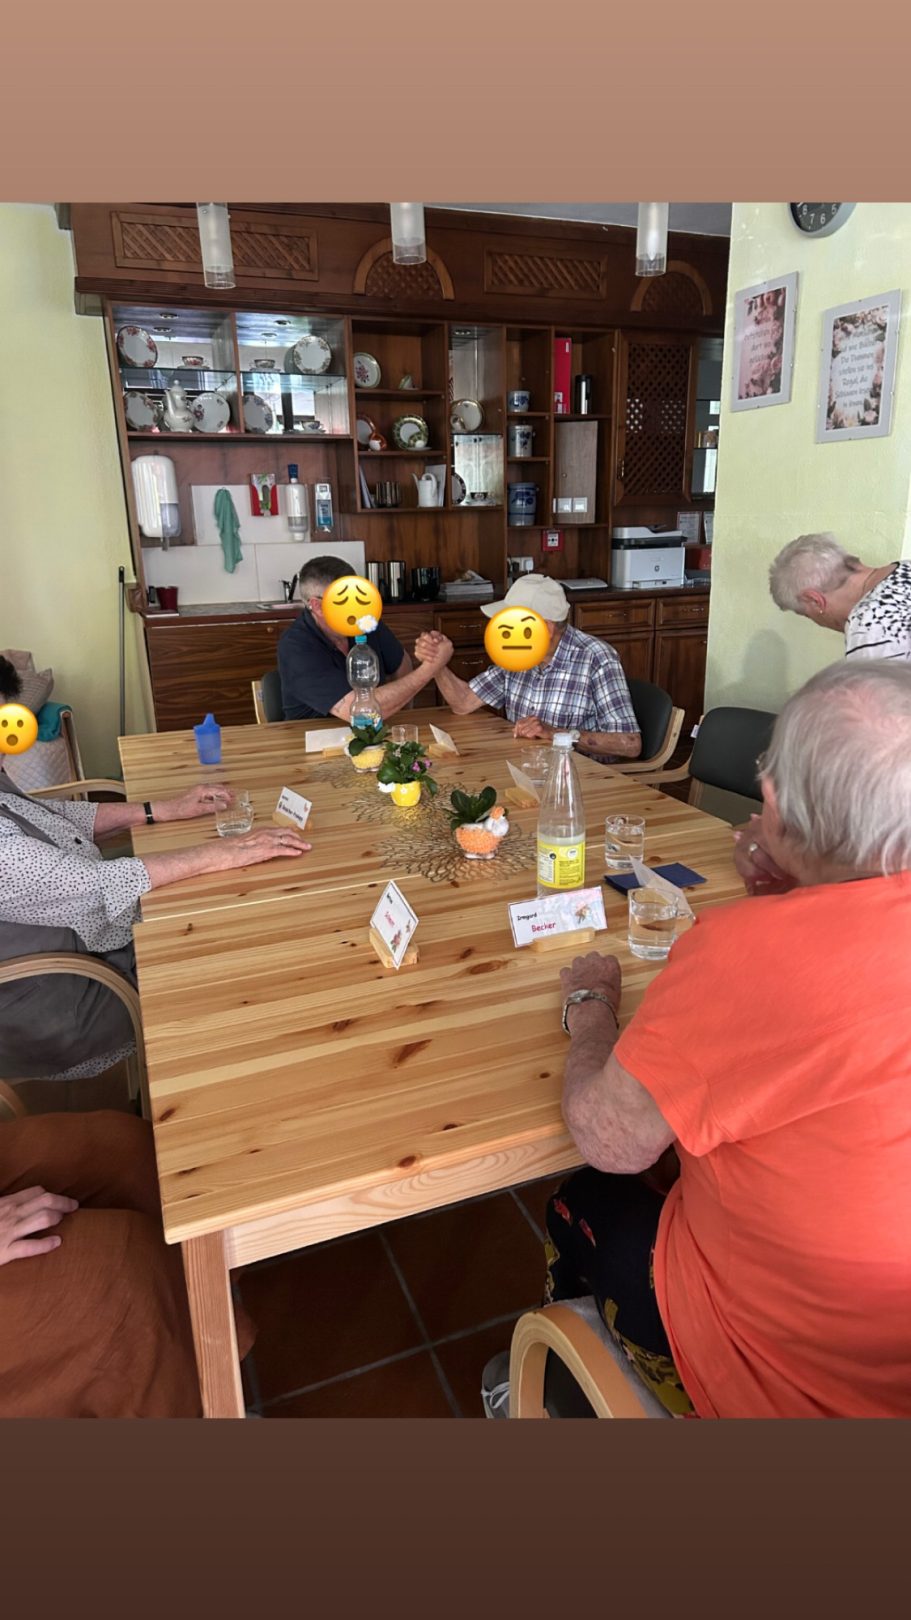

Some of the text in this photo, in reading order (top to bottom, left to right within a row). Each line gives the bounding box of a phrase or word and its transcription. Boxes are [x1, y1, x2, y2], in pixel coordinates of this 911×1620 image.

[802, 204, 808, 216] 8
[810, 213, 815, 224] 7
[820, 213, 826, 224] 6
[531, 922, 556, 932] Becker
